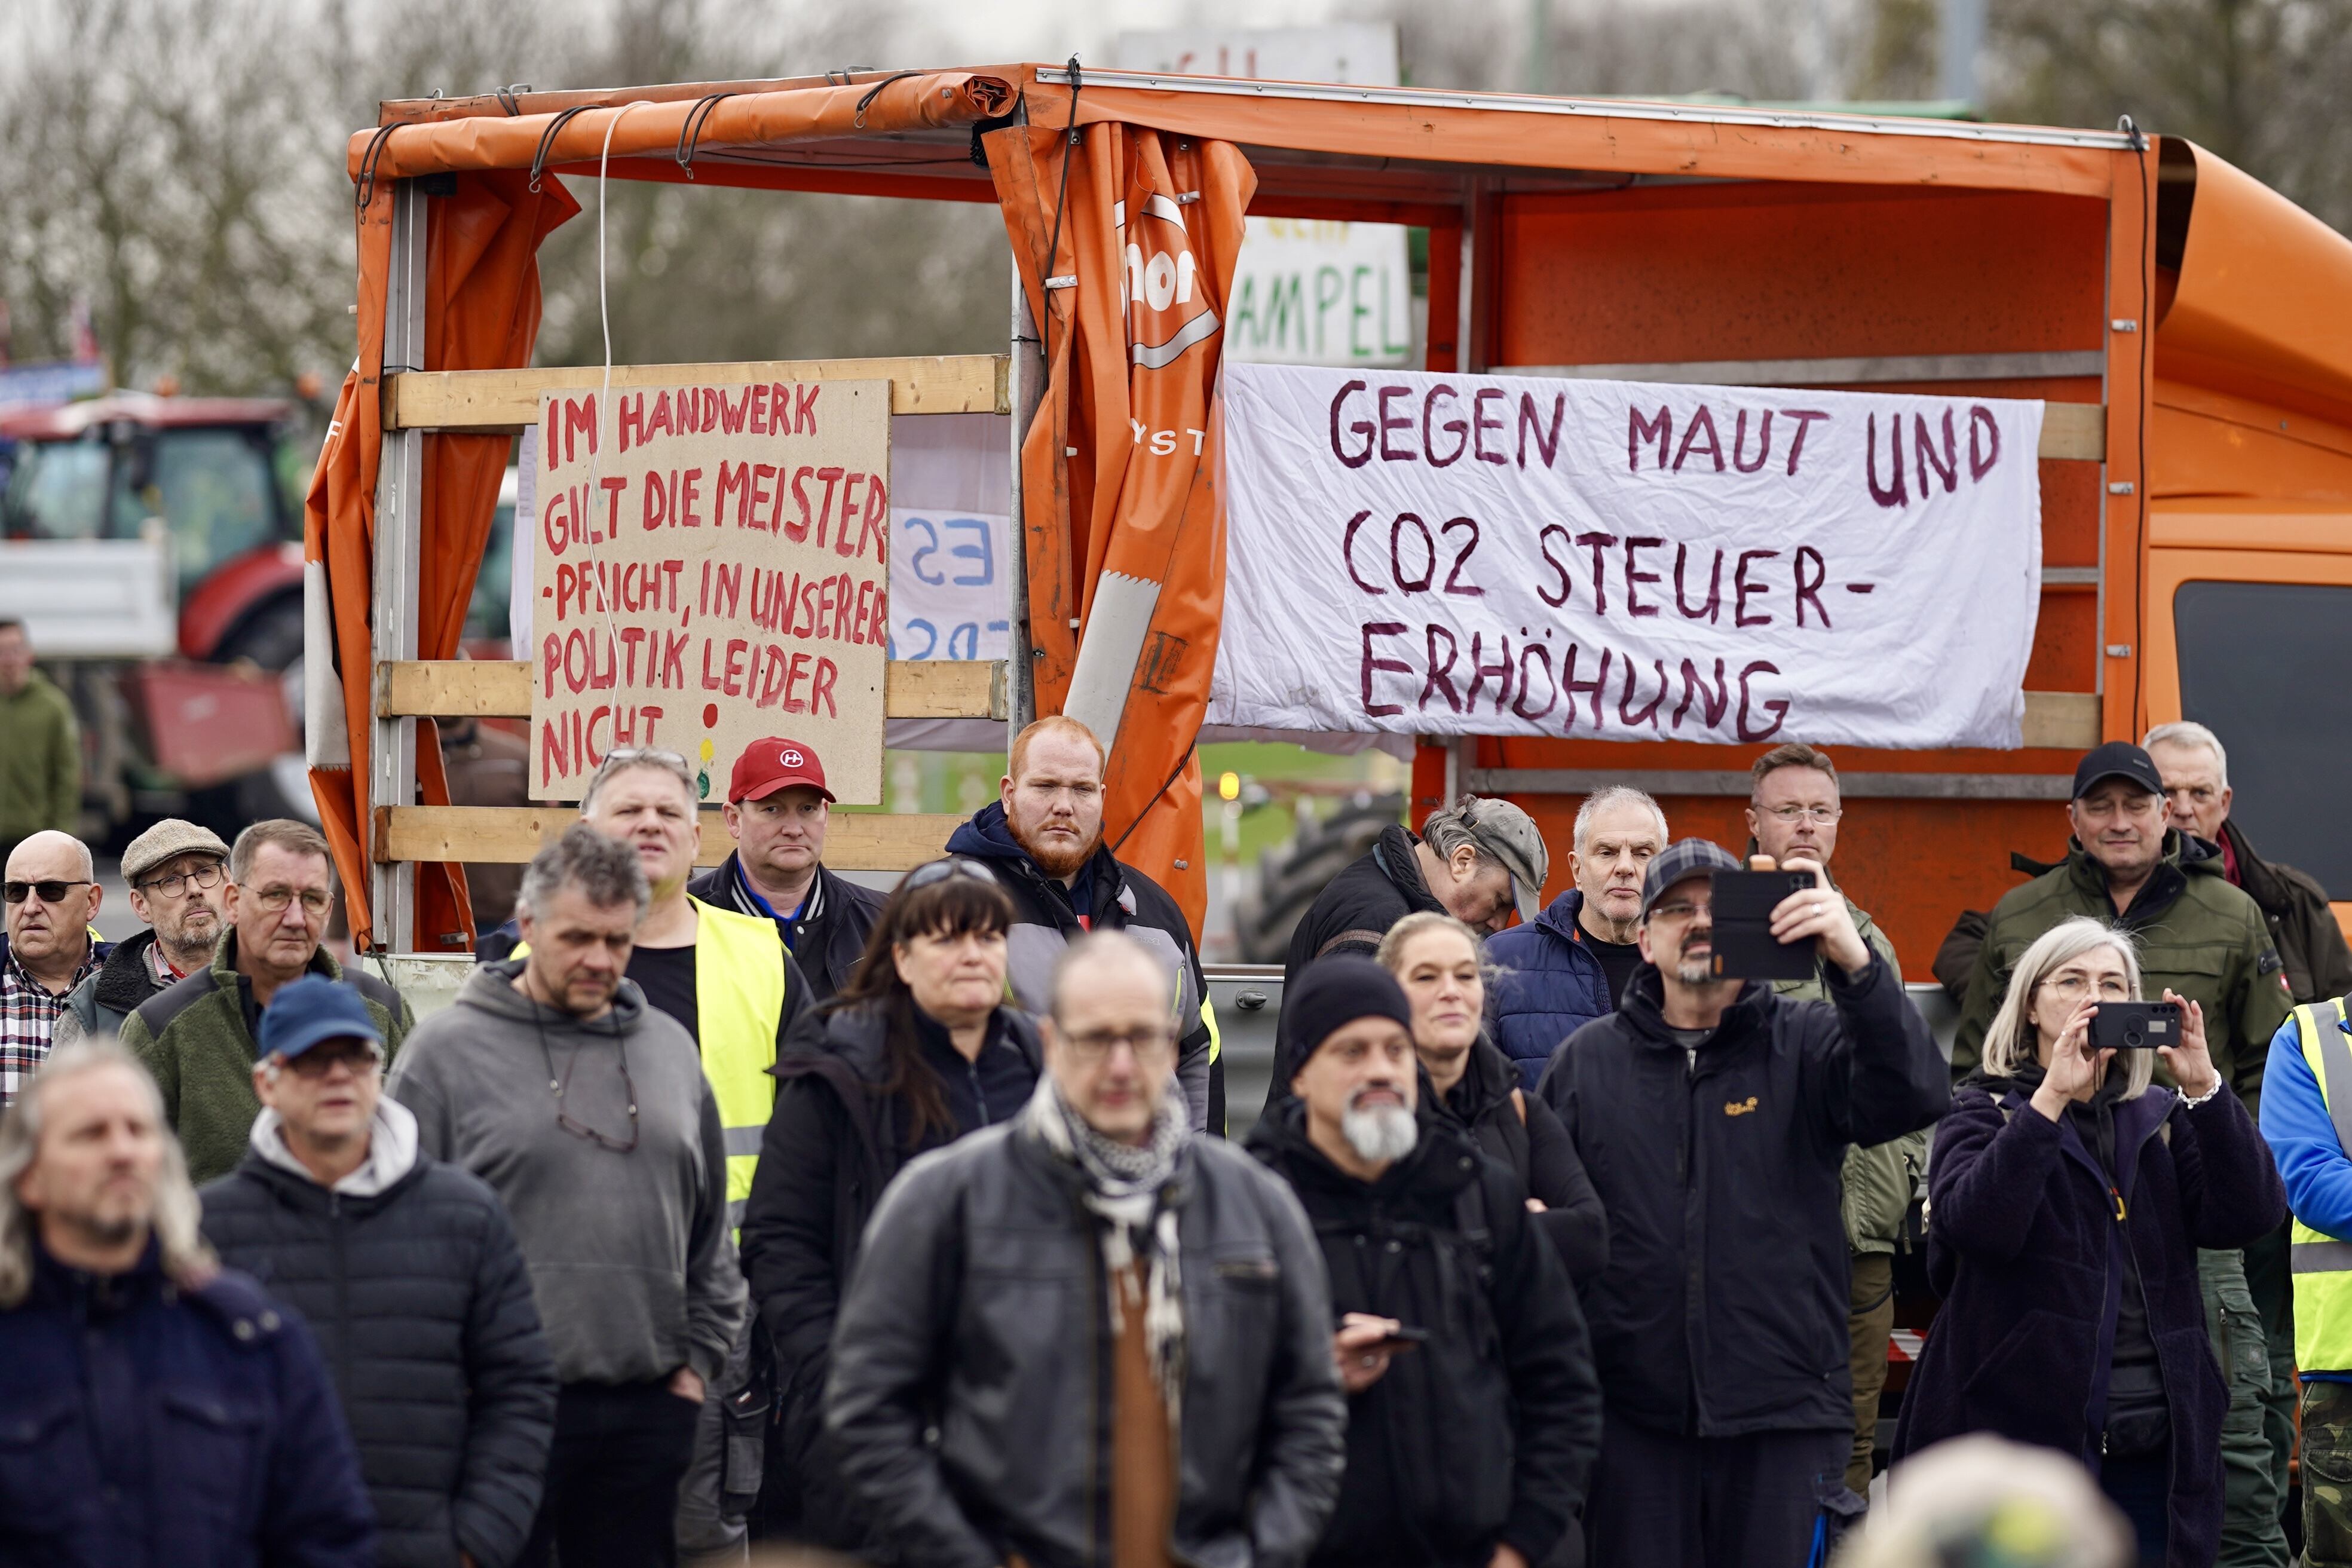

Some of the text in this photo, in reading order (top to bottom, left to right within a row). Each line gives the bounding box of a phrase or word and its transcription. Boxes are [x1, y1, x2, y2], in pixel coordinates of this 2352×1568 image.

[1231, 263, 1410, 356] AMPEL
[547, 384, 821, 471] IM HANDWERK
[1330, 380, 2000, 509] GEGEN MAUT UND
[544, 477, 627, 556] GILT
[643, 467, 703, 531] DIE
[700, 559, 742, 619] IN
[751, 567, 886, 647] UNSERER
[1343, 510, 1875, 629] CO2 STEUER-
[544, 624, 690, 699] POLITIK
[702, 638, 838, 718] LEIDER
[1361, 622, 1790, 742] ERHÖHUNG
[542, 703, 664, 788] NICHT
